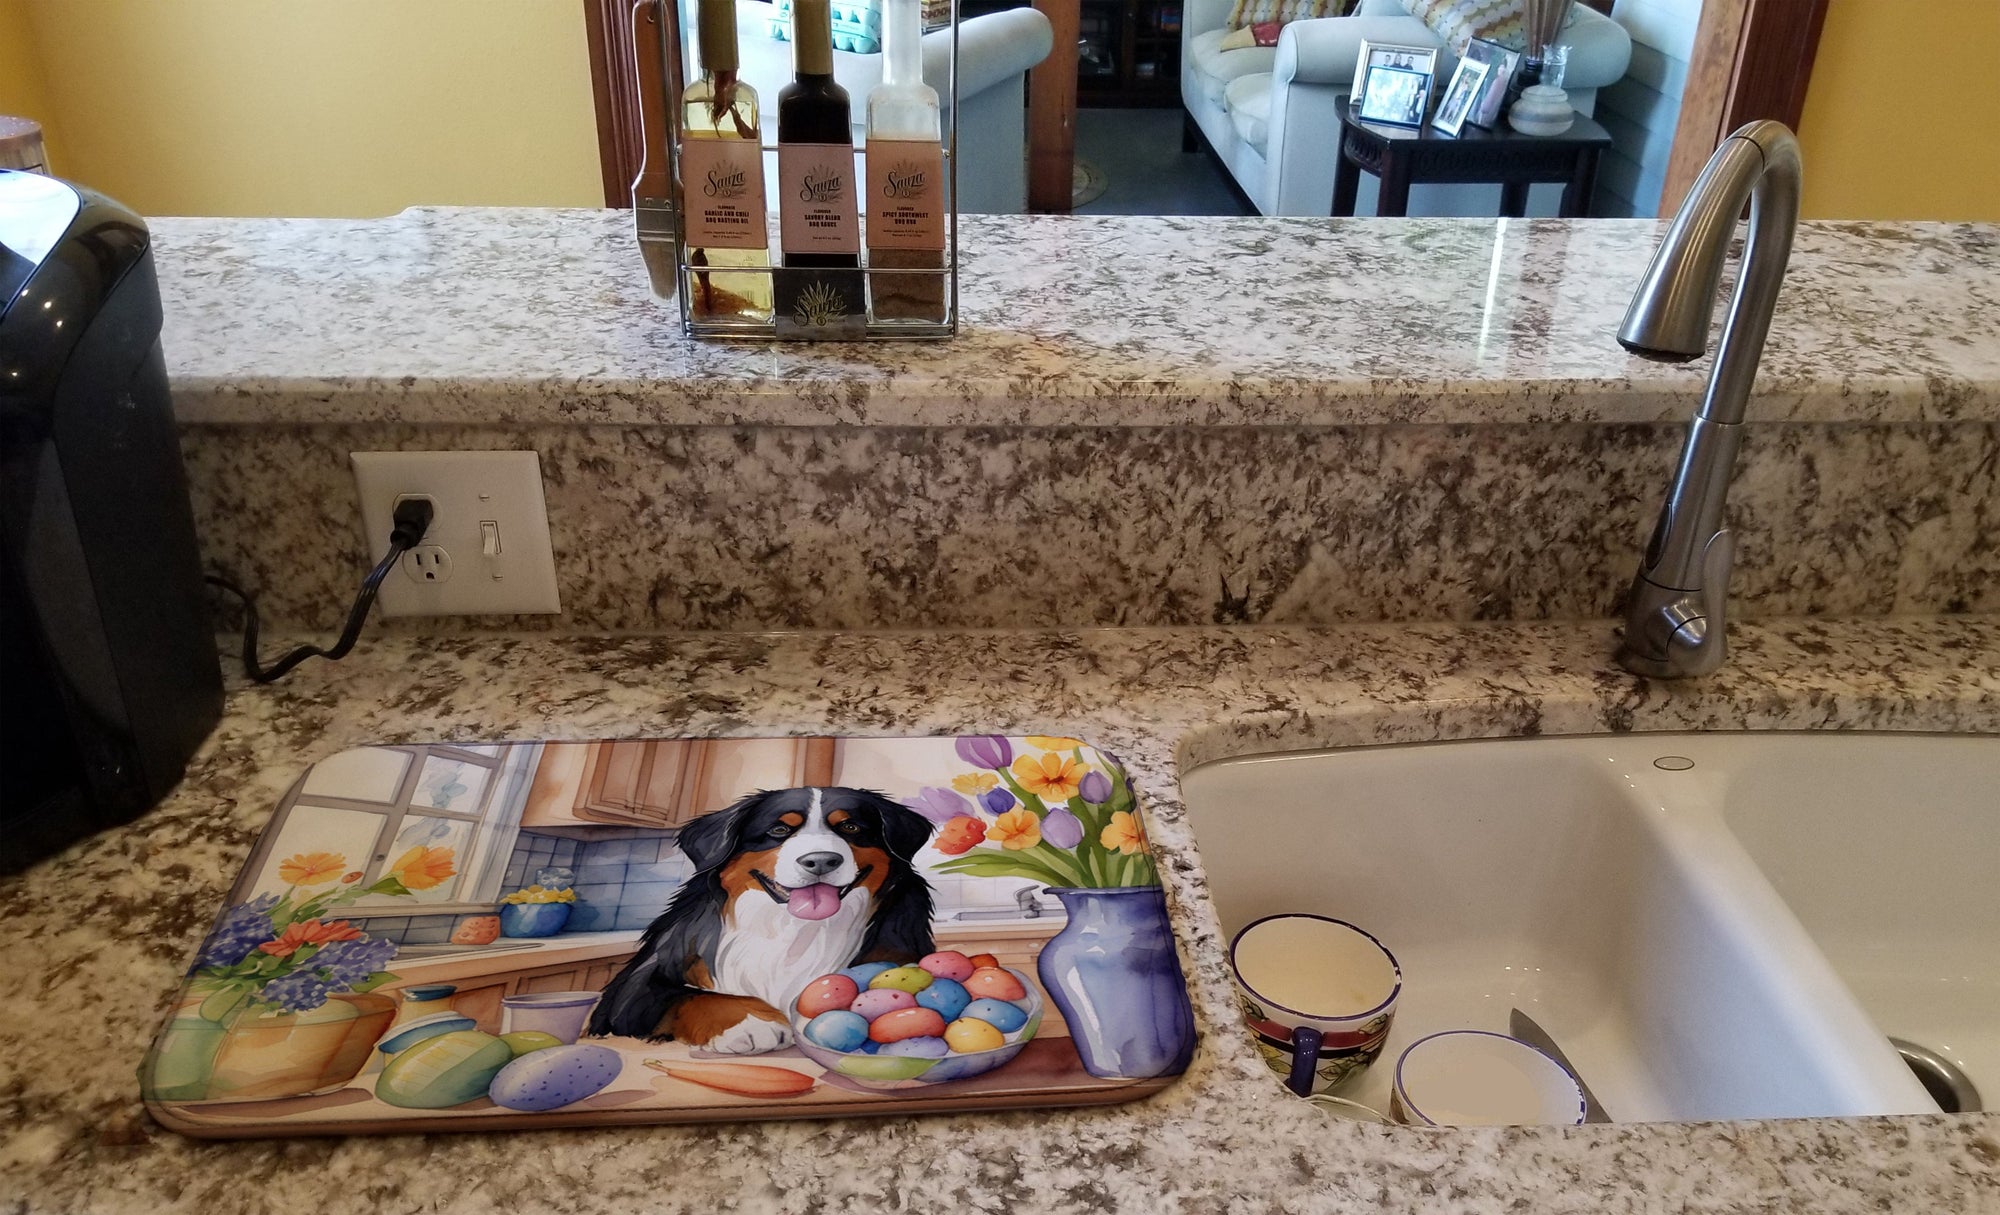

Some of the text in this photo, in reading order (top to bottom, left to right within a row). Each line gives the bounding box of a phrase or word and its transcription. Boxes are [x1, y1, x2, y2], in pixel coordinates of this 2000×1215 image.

[703, 169, 746, 198] Sauza
[800, 175, 842, 202] Sauza
[883, 171, 926, 199] Sauza
